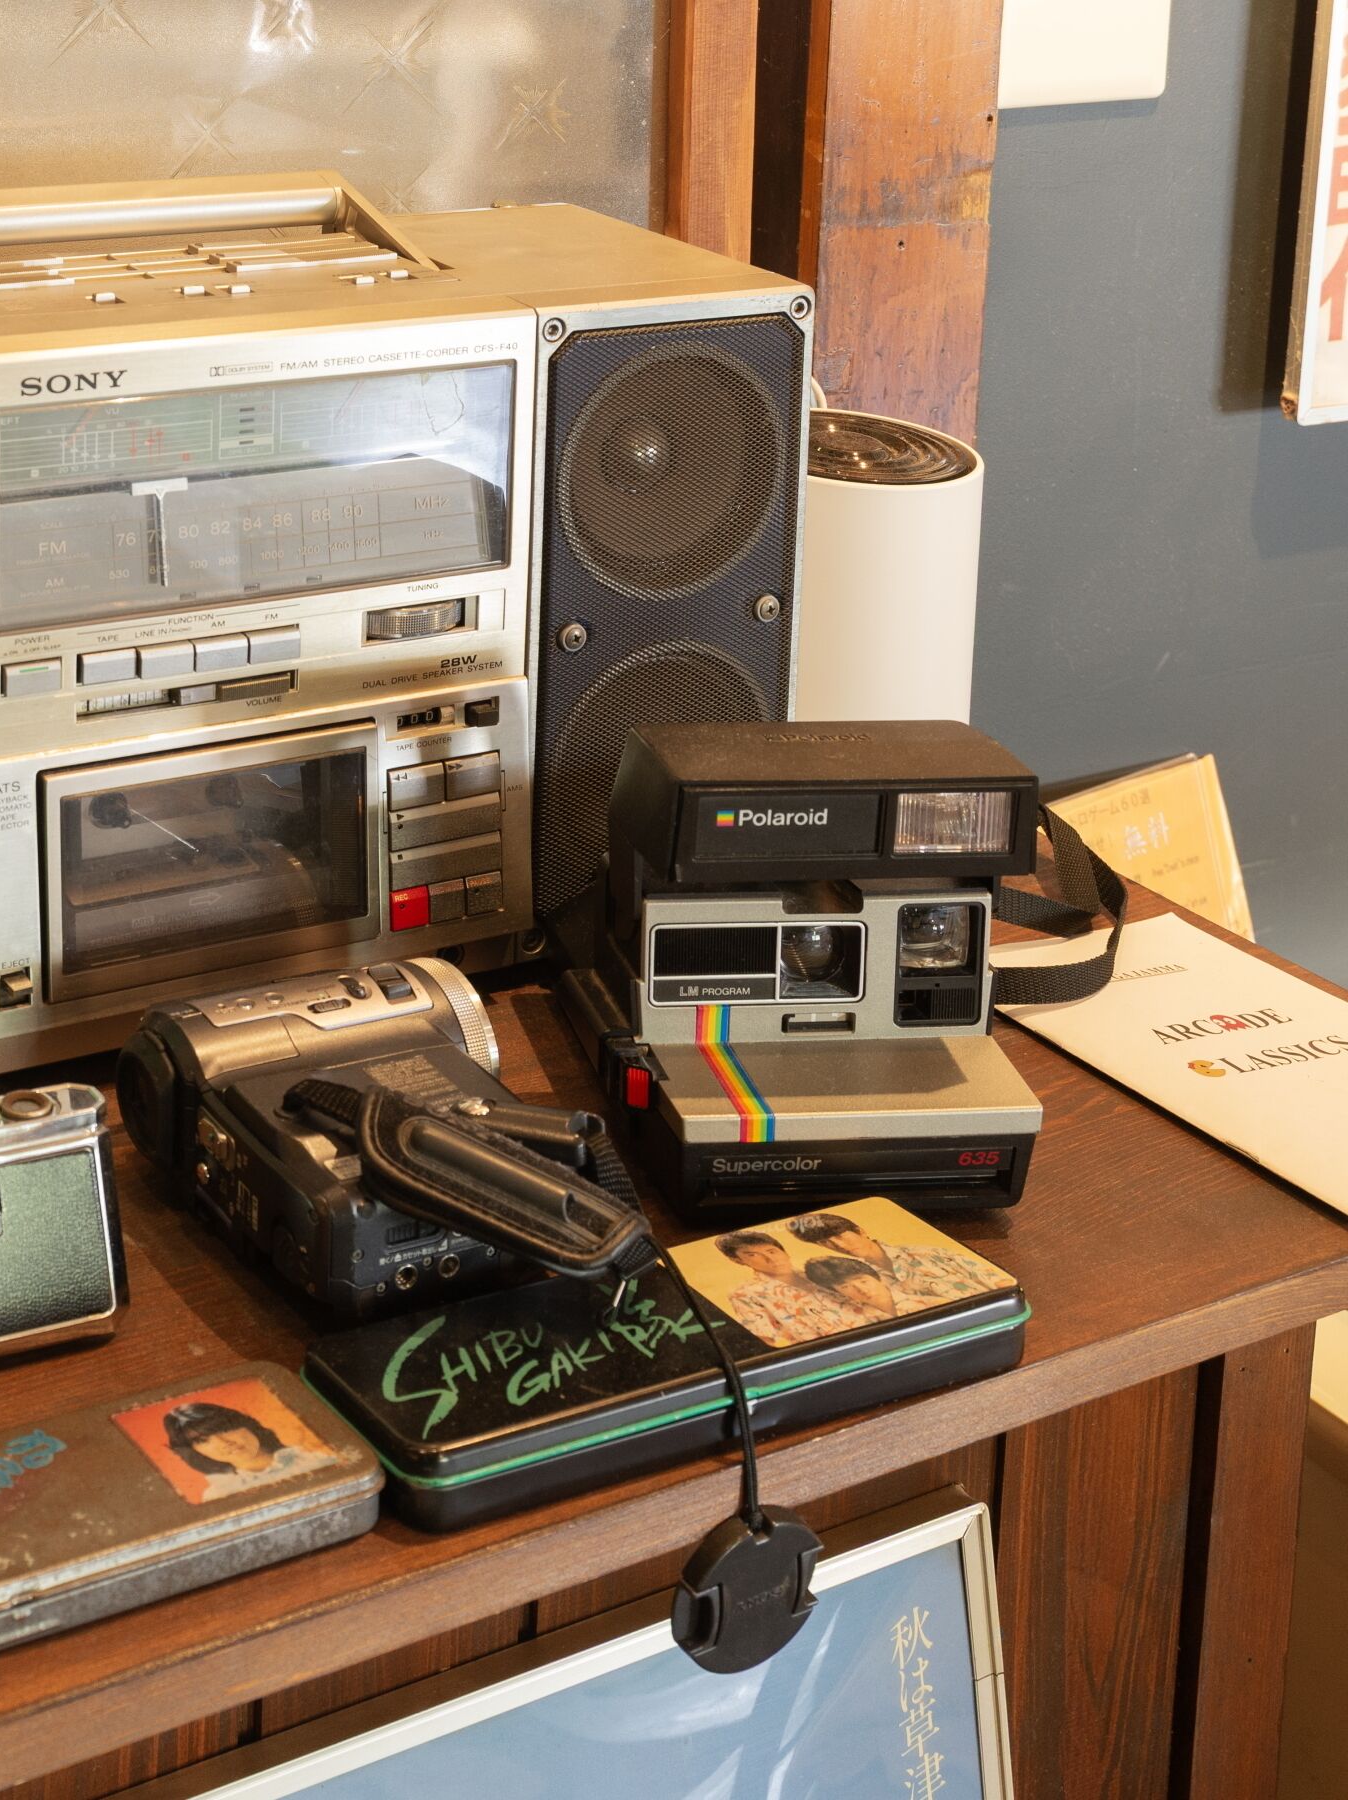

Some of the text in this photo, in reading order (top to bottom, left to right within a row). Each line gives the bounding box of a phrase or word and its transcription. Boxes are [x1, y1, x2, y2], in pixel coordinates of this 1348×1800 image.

[280, 342, 518, 371] FM/AM STEREO CASSETTE-CORDER CFS-F40
[20, 370, 128, 397] SONY
[0, 416, 21, 426] EFT
[38, 540, 67, 556] FM
[115, 532, 137, 547] 76
[178, 524, 199, 539] 80
[210, 521, 231, 536] 82
[242, 517, 262, 531] 84
[272, 512, 293, 528] 86
[311, 508, 331, 523] 88
[342, 504, 363, 519] 90
[413, 496, 451, 511] MHz
[45, 577, 64, 588] AM
[189, 558, 208, 570] 700
[218, 555, 238, 567] 800
[260, 549, 285, 561] 1000
[407, 583, 439, 593] TUNING
[168, 613, 214, 625] FUNCTION
[265, 613, 278, 621] FM
[211, 620, 226, 629] AM
[14, 635, 50, 646] POWER
[97, 634, 119, 643] TAPE
[135, 629, 156, 639] LINE
[440, 655, 477, 669] 28W
[362, 661, 503, 689] DUAL DRIVE SPEAKER SYSTEM
[246, 695, 282, 708] VOLUME
[396, 737, 452, 751] TAPE COUNTER
[506, 784, 523, 793] AMS
[738, 808, 828, 827] Polaroid
[1124, 811, 1170, 860] 無料
[394, 893, 409, 902] REC
[2, 958, 31, 969] EJECT
[679, 986, 751, 997] LM PROGRAM
[1152, 1008, 1293, 1045] ARCDE
[1187, 1035, 1348, 1078] LASSICS
[958, 1151, 1000, 1166] 635
[712, 1157, 822, 1176] Supercolor
[382, 1315, 543, 1440] SHIBU
[889, 1606, 947, 1800] 秋は草津
